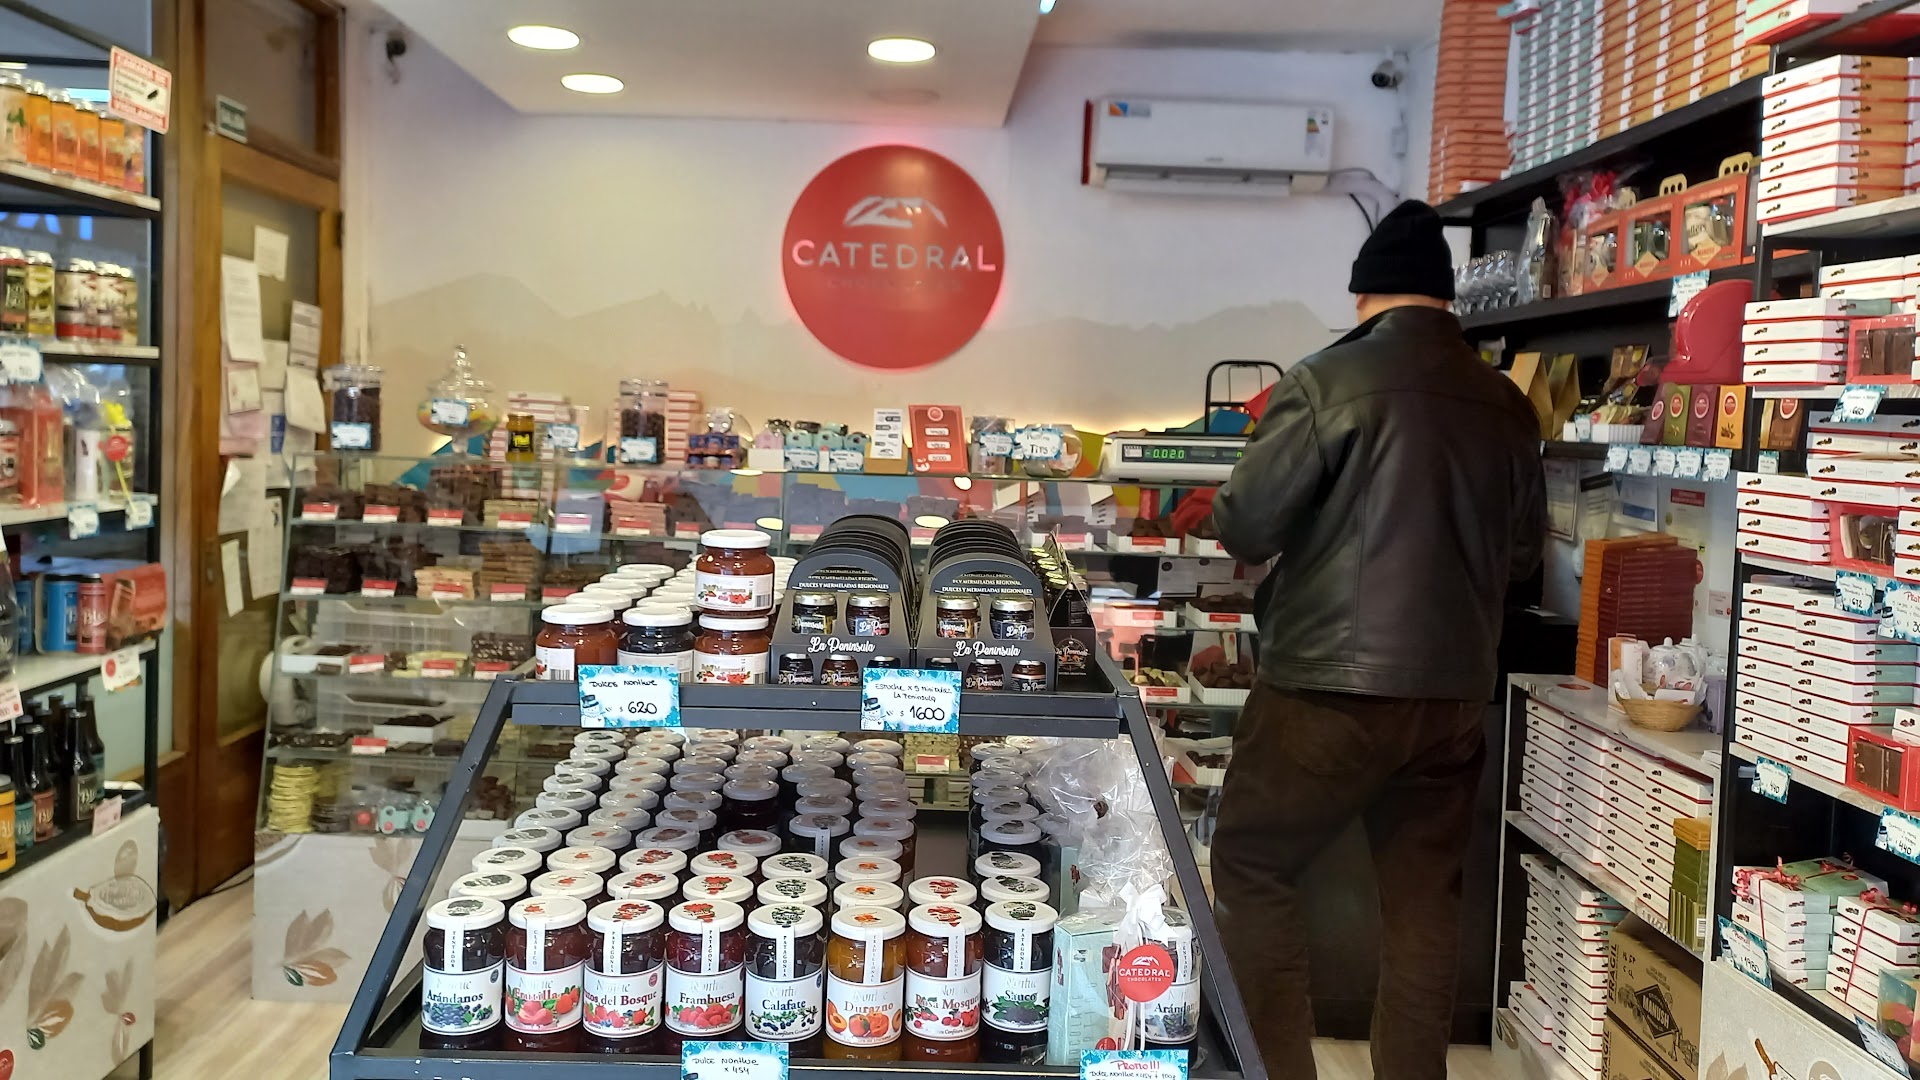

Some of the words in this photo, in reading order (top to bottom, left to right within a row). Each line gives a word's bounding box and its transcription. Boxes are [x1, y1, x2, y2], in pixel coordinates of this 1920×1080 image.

[791, 239, 997, 272] CATEDRAL
[807, 636, 827, 653] La
[827, 637, 876, 654] Peninsula
[953, 640, 972, 657] La
[972, 641, 1021, 657] Peninsula
[628, 701, 658, 715] 620
[910, 705, 945, 721] 1600
[1119, 968, 1171, 978] CATEDRAL
[1608, 943, 1619, 1001] FRAGIL
[427, 989, 484, 1004] Arándanos
[601, 995, 617, 1006] del
[620, 990, 657, 1006] Bosque
[679, 992, 736, 1005] Frambuesa
[762, 999, 806, 1011] Calafate
[844, 1001, 894, 1014] Durazno
[1642, 994, 1670, 1030] MANUSH
[733, 1066, 749, 1075] 454
